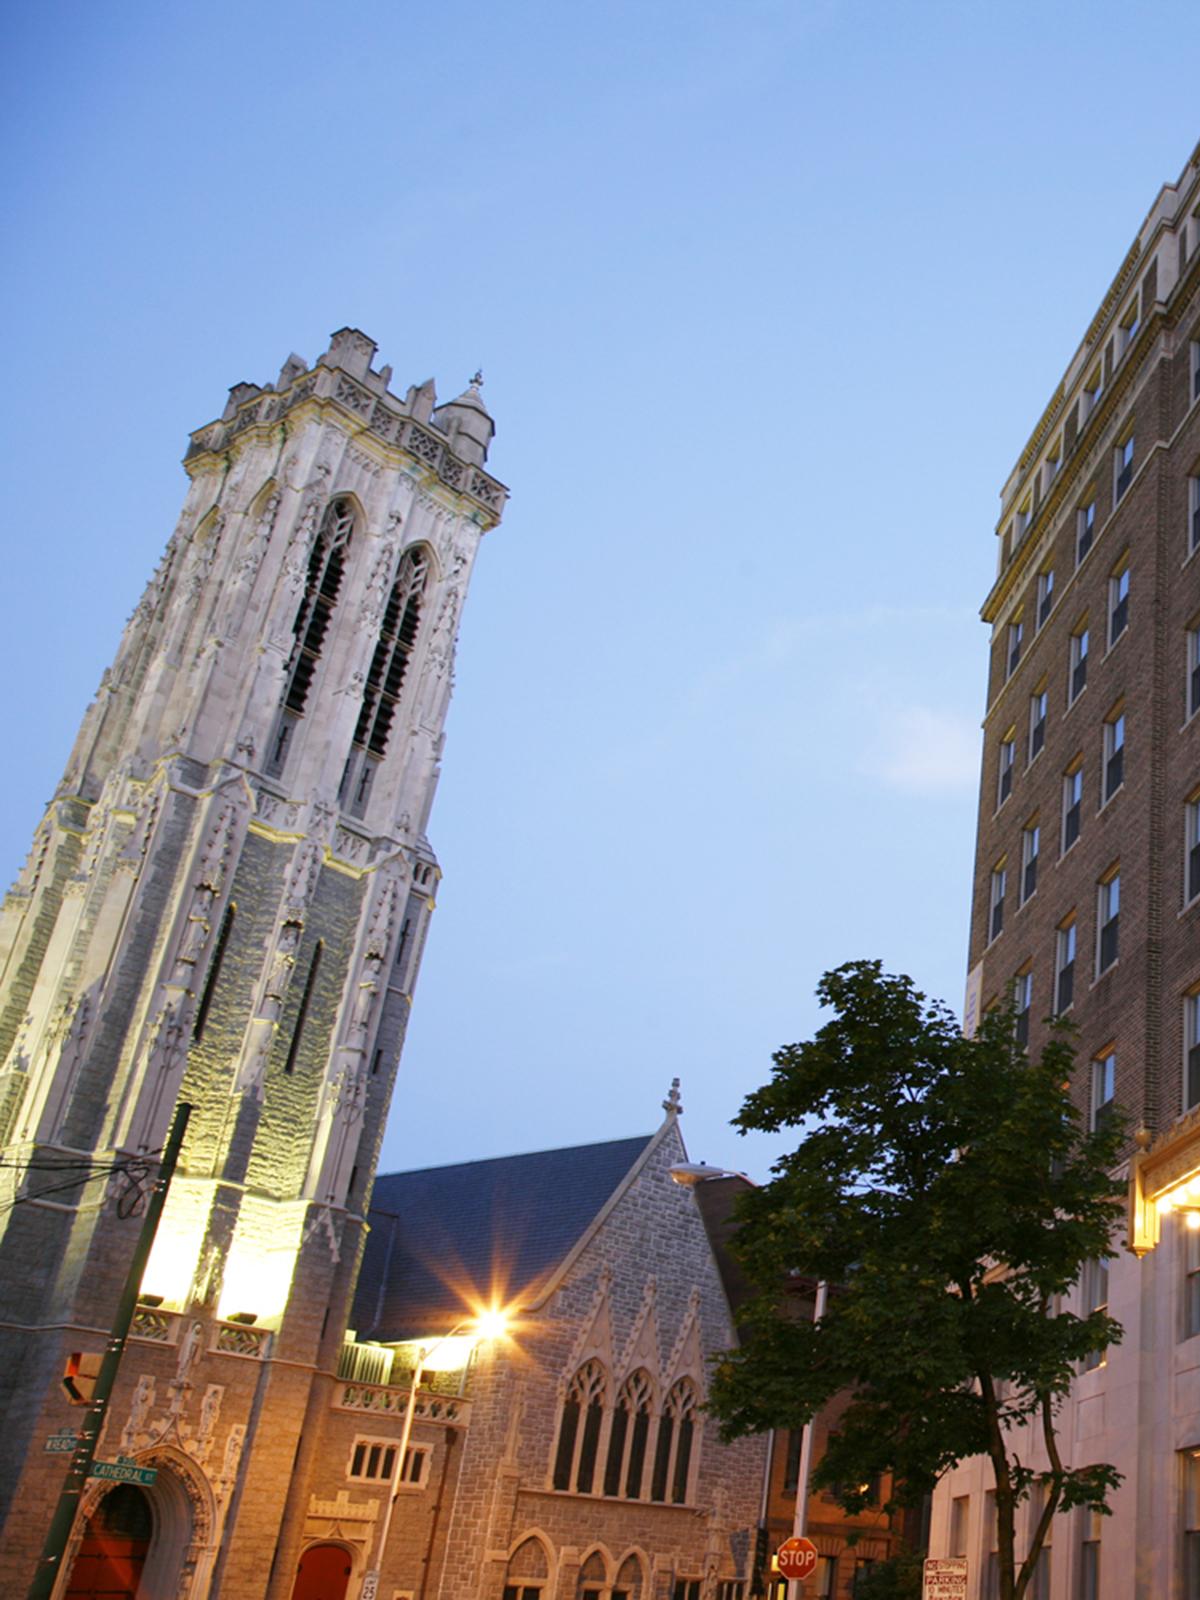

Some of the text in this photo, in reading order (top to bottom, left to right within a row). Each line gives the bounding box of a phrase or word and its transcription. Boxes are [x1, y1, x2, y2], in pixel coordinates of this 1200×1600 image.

[93, 1463, 143, 1482] CATHEDRAL
[779, 1550, 814, 1567] STOP
[927, 1560, 967, 1570] NO STOPPING
[926, 1576, 967, 1585] PARKING
[363, 1586, 375, 1600] 25
[938, 1585, 964, 1594] MINUTES
